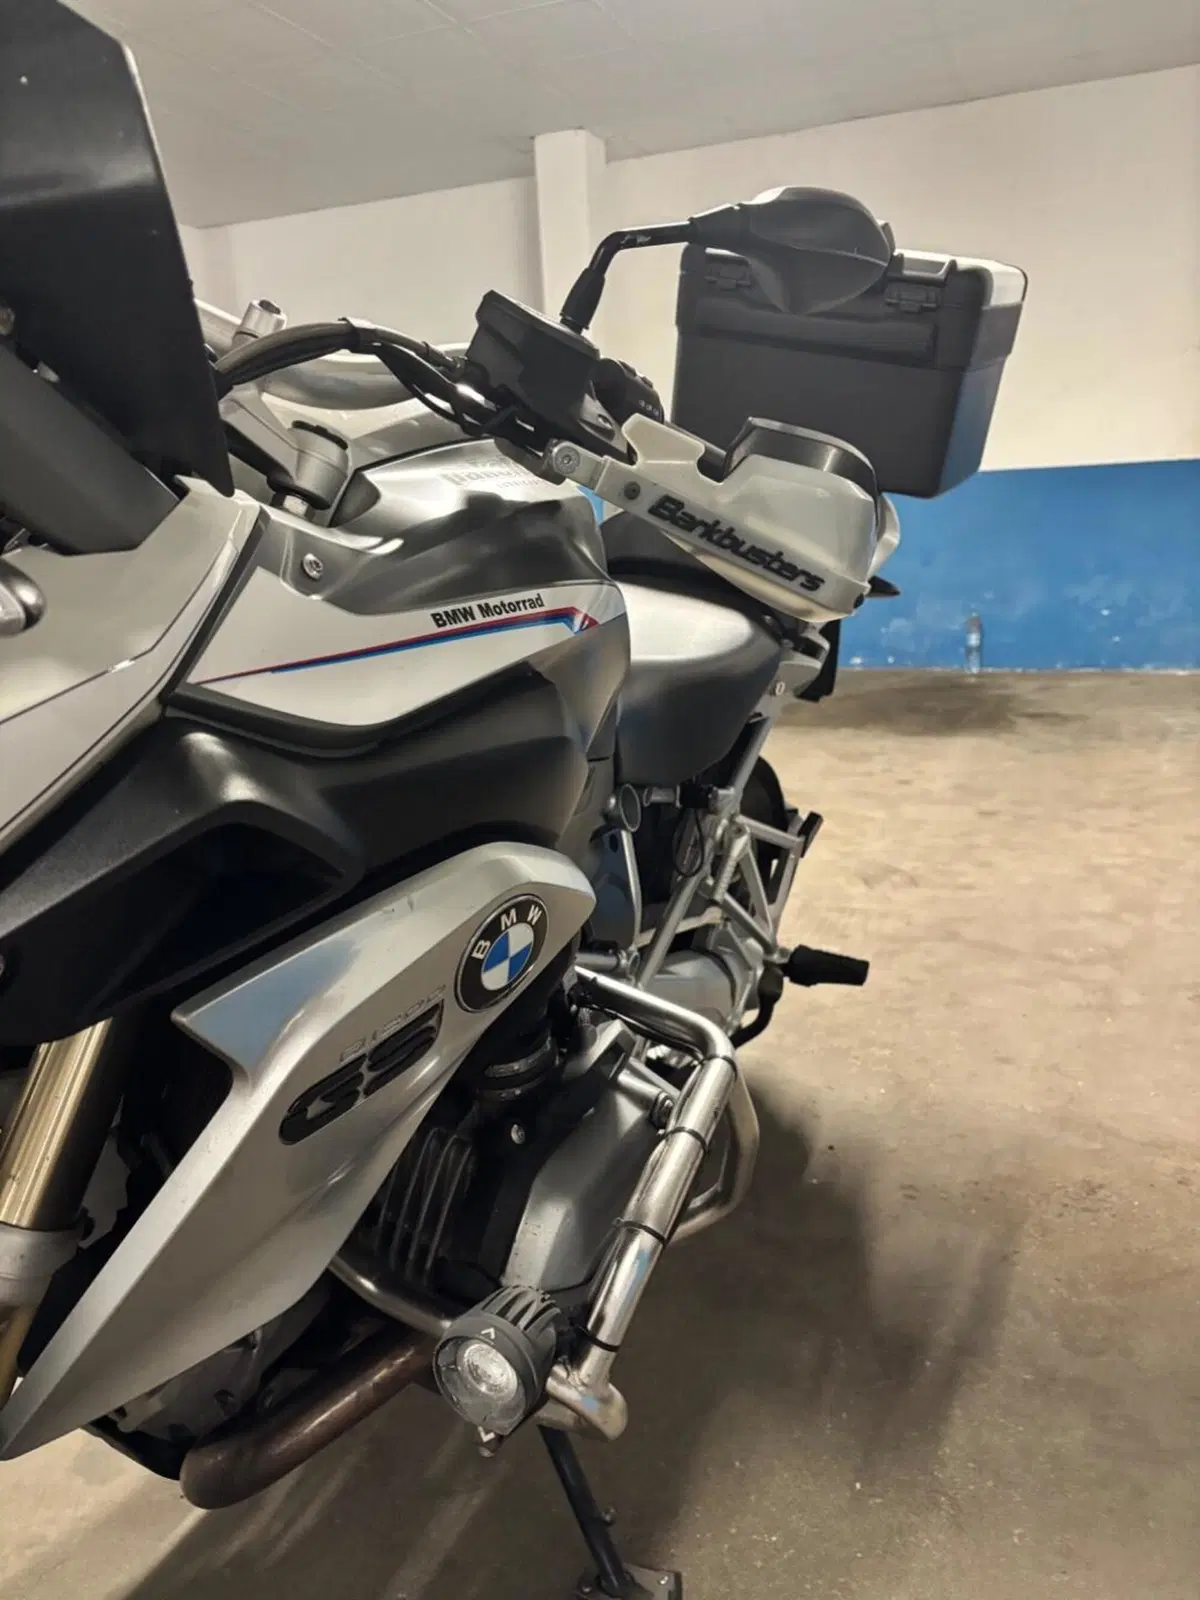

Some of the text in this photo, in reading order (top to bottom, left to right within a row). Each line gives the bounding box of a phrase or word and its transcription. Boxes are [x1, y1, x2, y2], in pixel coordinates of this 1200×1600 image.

[647, 494, 826, 592] Barkbusters
[430, 592, 545, 628] BMW Motorrad
[471, 904, 543, 960] BMW
[278, 998, 445, 1146] GS
